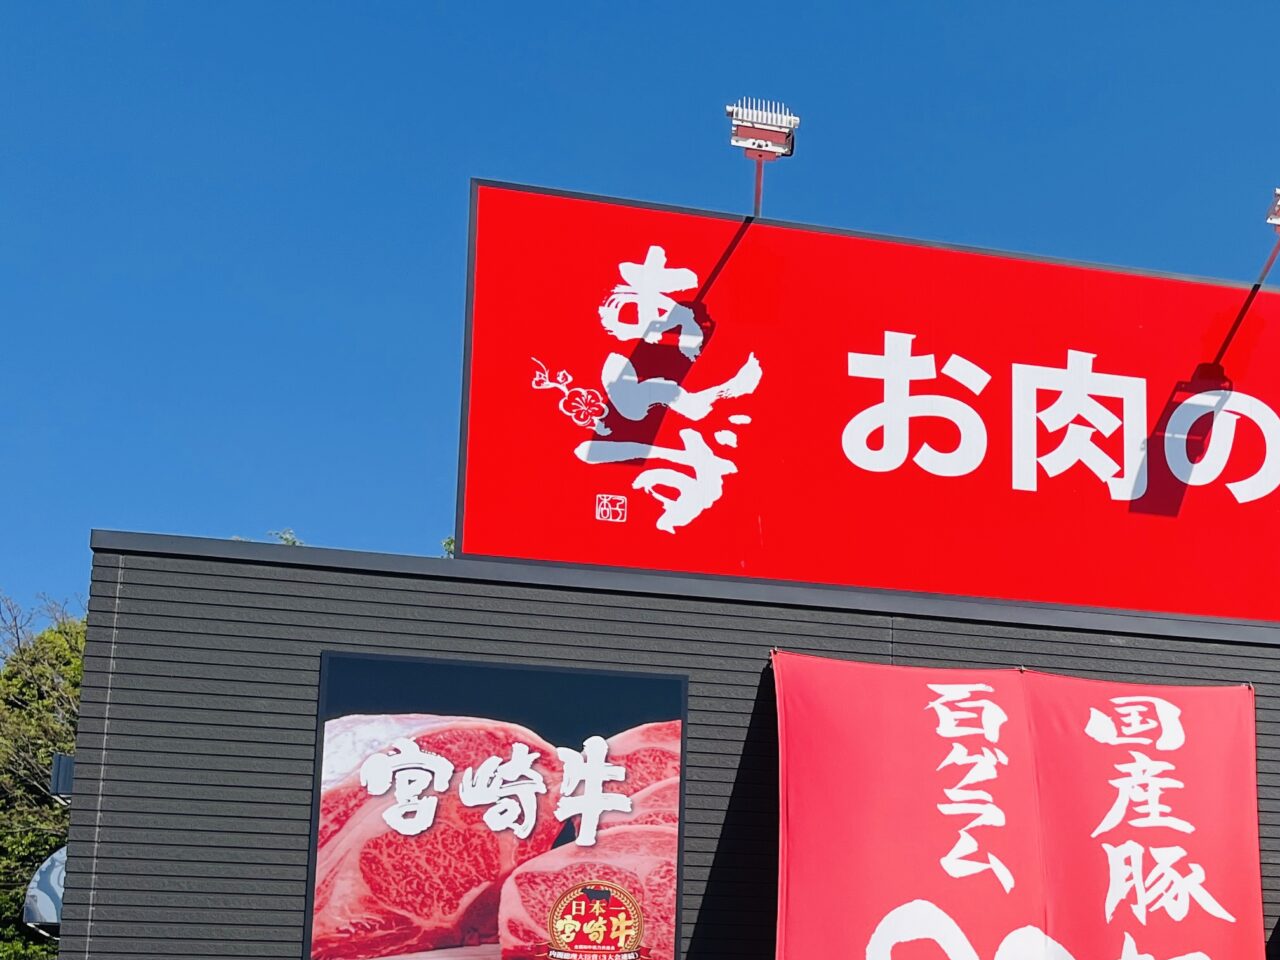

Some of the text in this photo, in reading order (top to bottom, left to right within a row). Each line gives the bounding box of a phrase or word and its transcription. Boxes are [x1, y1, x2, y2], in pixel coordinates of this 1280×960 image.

[573, 245, 763, 535] あんず
[360, 735, 633, 847] 宮崎牛
[555, 912, 637, 948] 宮崎牛
[571, 900, 627, 916] 日本一
